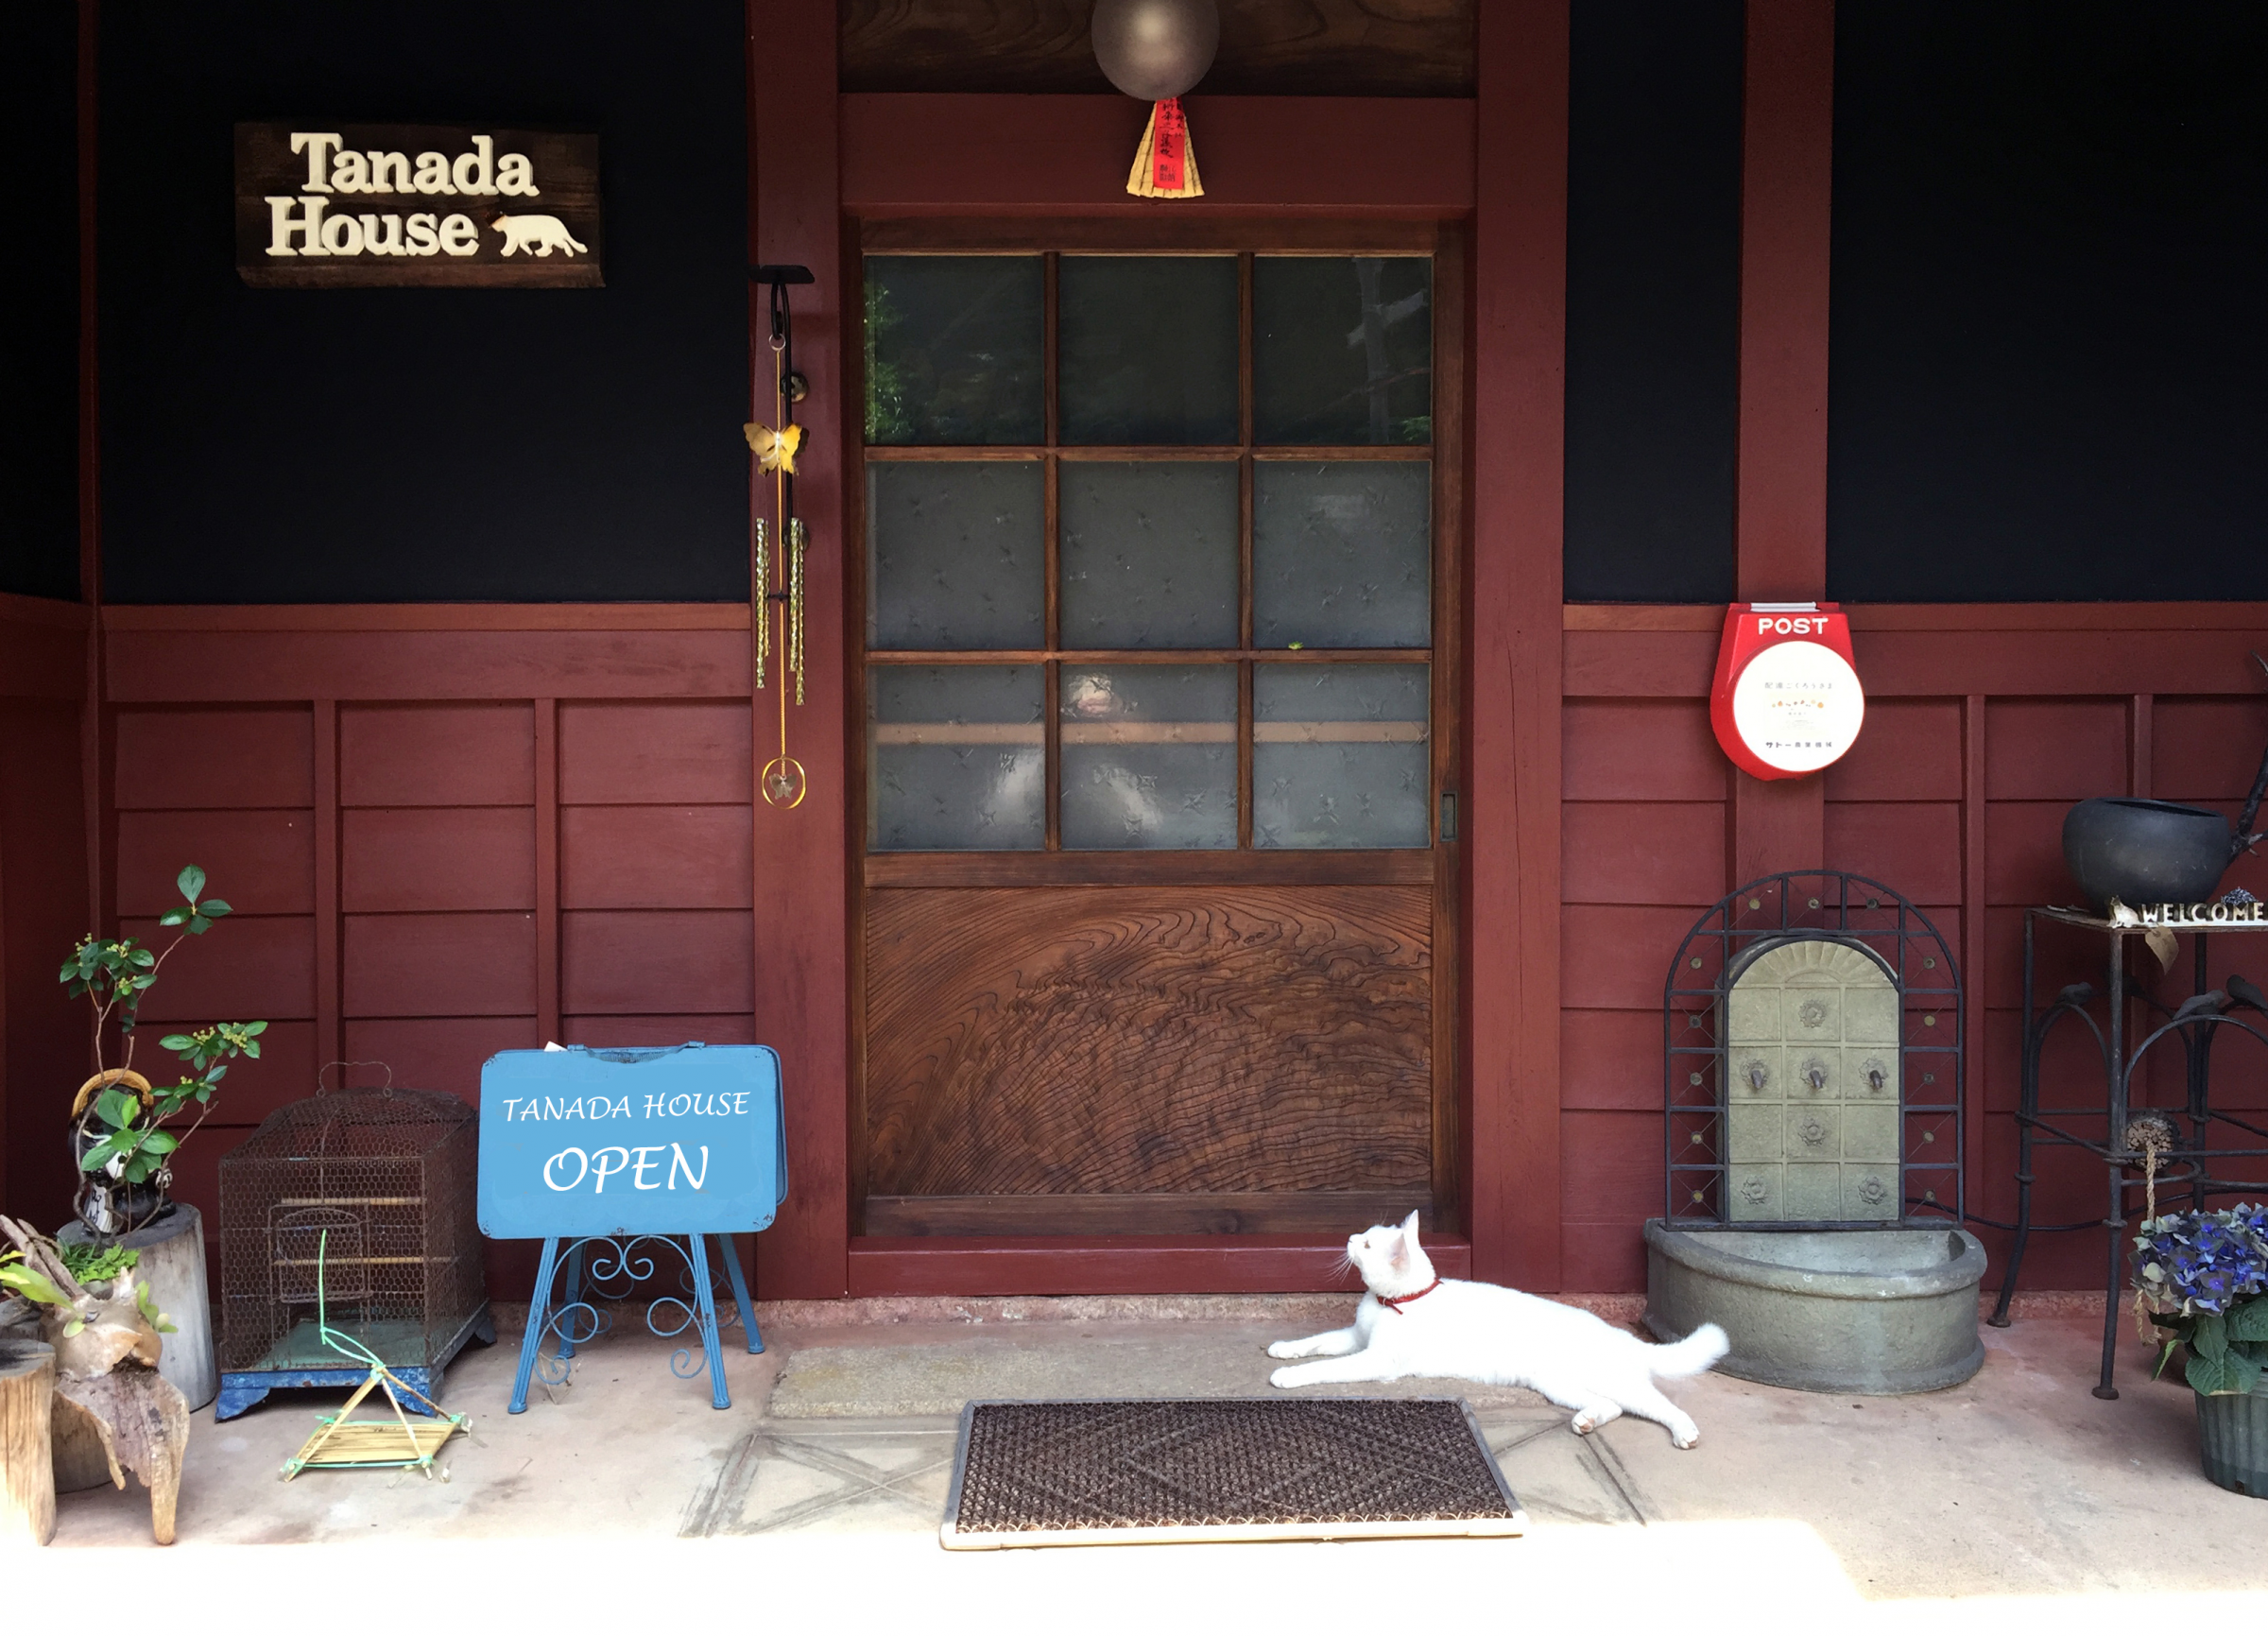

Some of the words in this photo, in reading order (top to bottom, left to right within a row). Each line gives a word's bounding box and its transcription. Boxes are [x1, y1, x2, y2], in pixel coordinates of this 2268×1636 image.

[290, 132, 541, 197] Tanada
[265, 196, 480, 257] House
[1758, 617, 1829, 635] POST
[2141, 902, 2265, 925] WELCOME
[503, 1095, 632, 1122] TANADA
[643, 1091, 751, 1119] HOUSE
[542, 1142, 709, 1194] OPEN
